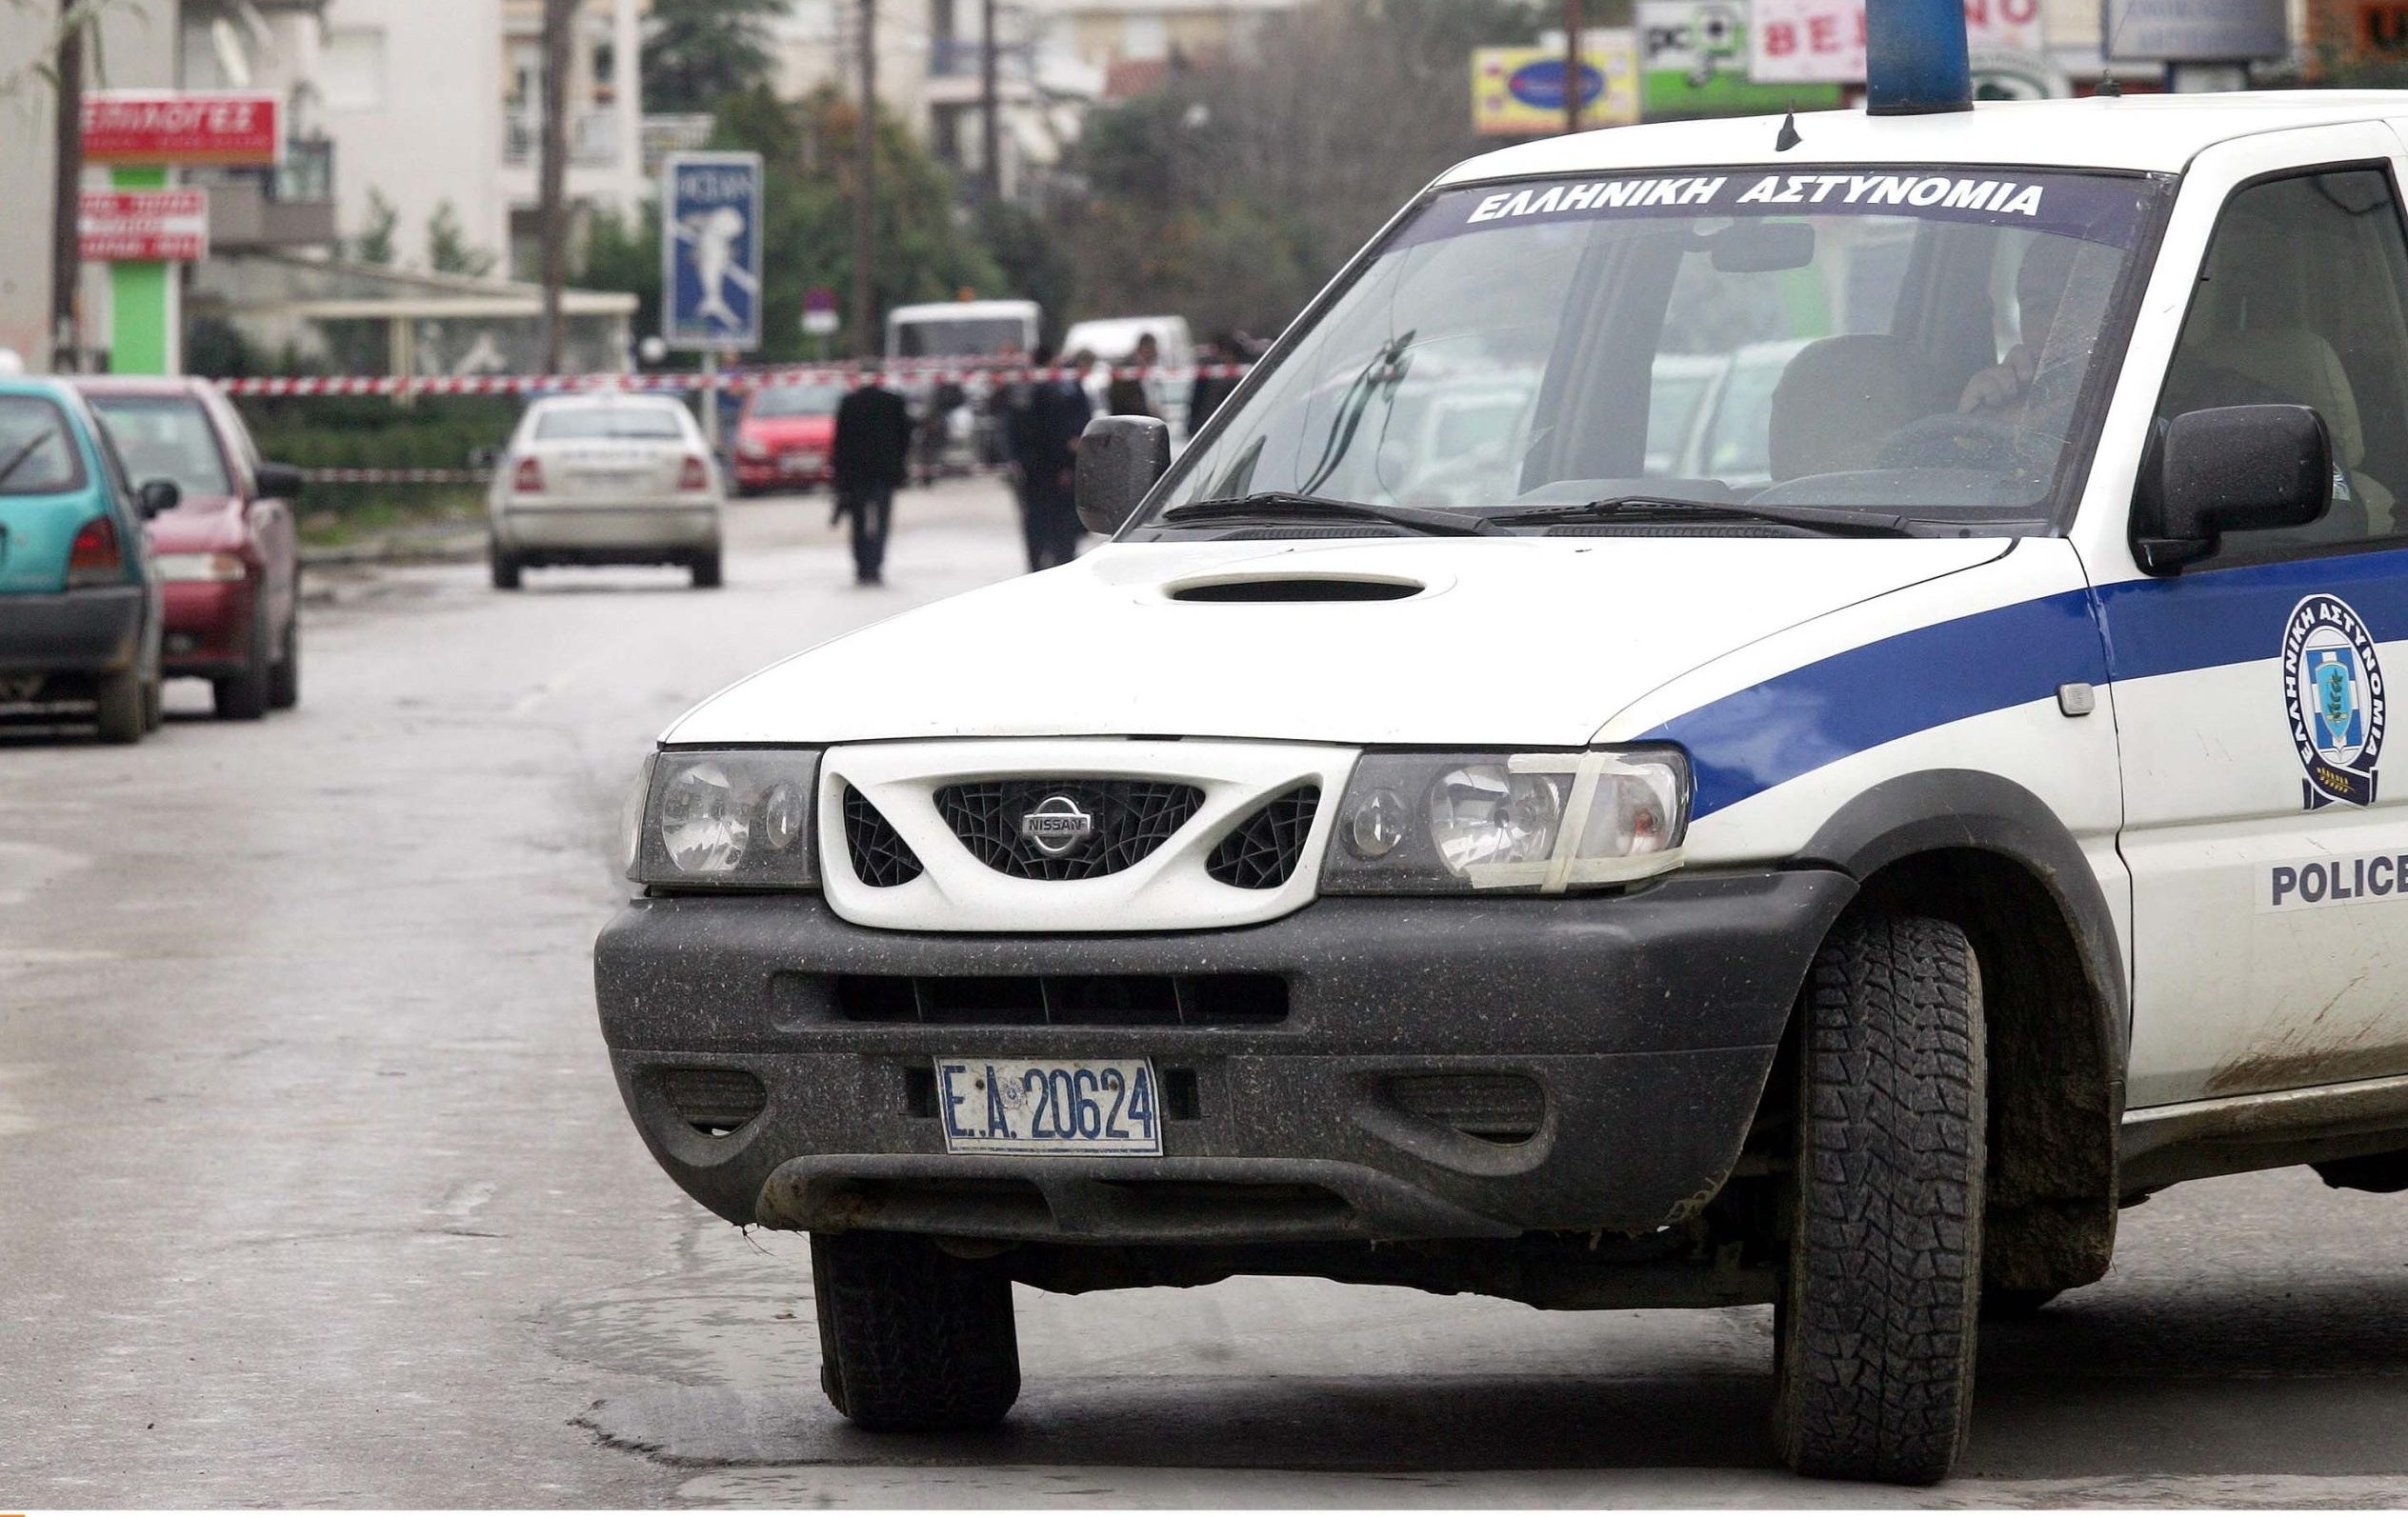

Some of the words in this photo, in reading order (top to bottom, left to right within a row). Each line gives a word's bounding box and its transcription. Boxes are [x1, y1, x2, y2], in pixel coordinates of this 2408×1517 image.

[1466, 177, 1728, 224] ΕΛΛΗΝΙΚΗ
[1736, 175, 2044, 216] ΑΣΤΥΝΟΜΙΑ
[2285, 607, 2317, 765] ΕΛΛΗΝΙΚΗ
[2318, 602, 2385, 758] ΑΣΤΥΝΟΜΙΑ
[1029, 818, 1082, 831] NISSAN
[1023, 1067, 1154, 1140] 20624
